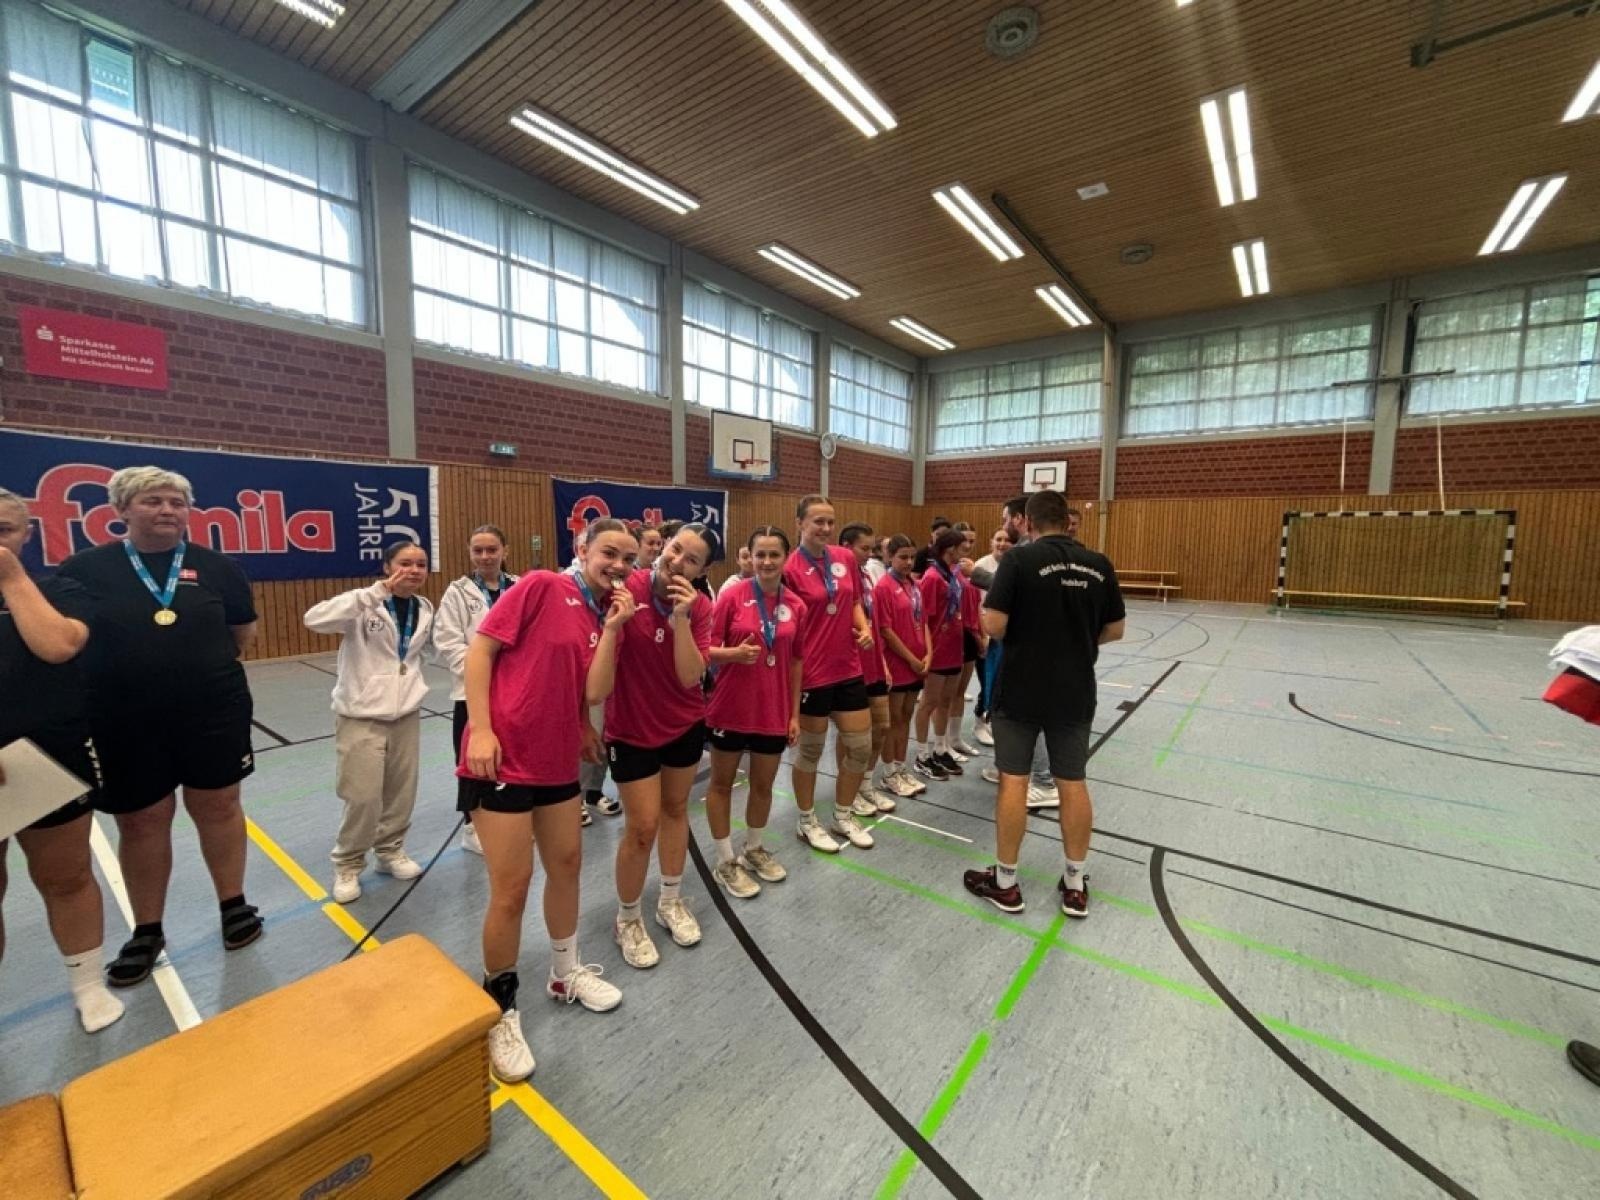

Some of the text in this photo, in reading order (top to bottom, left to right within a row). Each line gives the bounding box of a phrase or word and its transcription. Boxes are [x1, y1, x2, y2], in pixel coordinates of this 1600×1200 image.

[58, 335, 117, 351] Sparkasse
[60, 345, 155, 366] Mittelholstein AG
[353, 482, 383, 561] JAHRE
[588, 632, 598, 648] 9
[655, 627, 665, 643] 8
